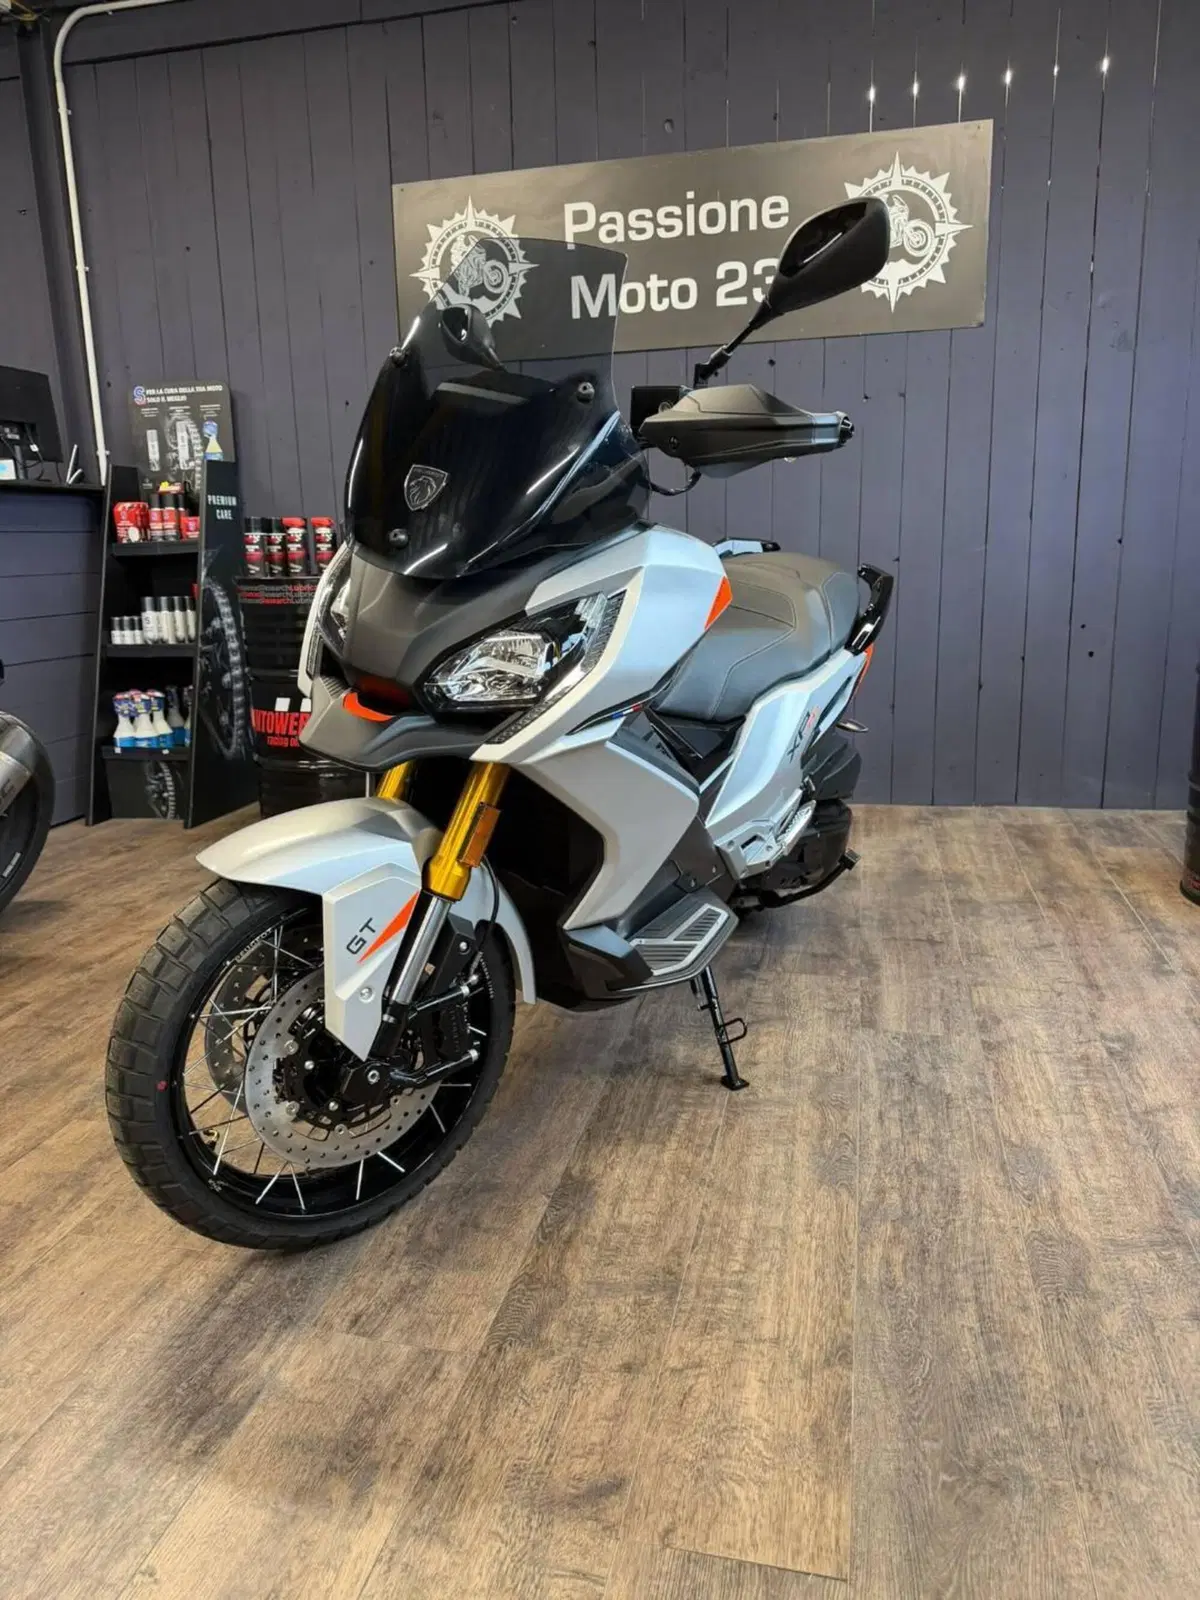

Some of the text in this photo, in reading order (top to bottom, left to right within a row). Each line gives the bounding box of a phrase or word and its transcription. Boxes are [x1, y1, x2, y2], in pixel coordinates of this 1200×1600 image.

[564, 190, 789, 249] Passione
[571, 257, 781, 319] Moto 23
[207, 494, 237, 506] PREMIUM
[346, 917, 376, 955] GT
